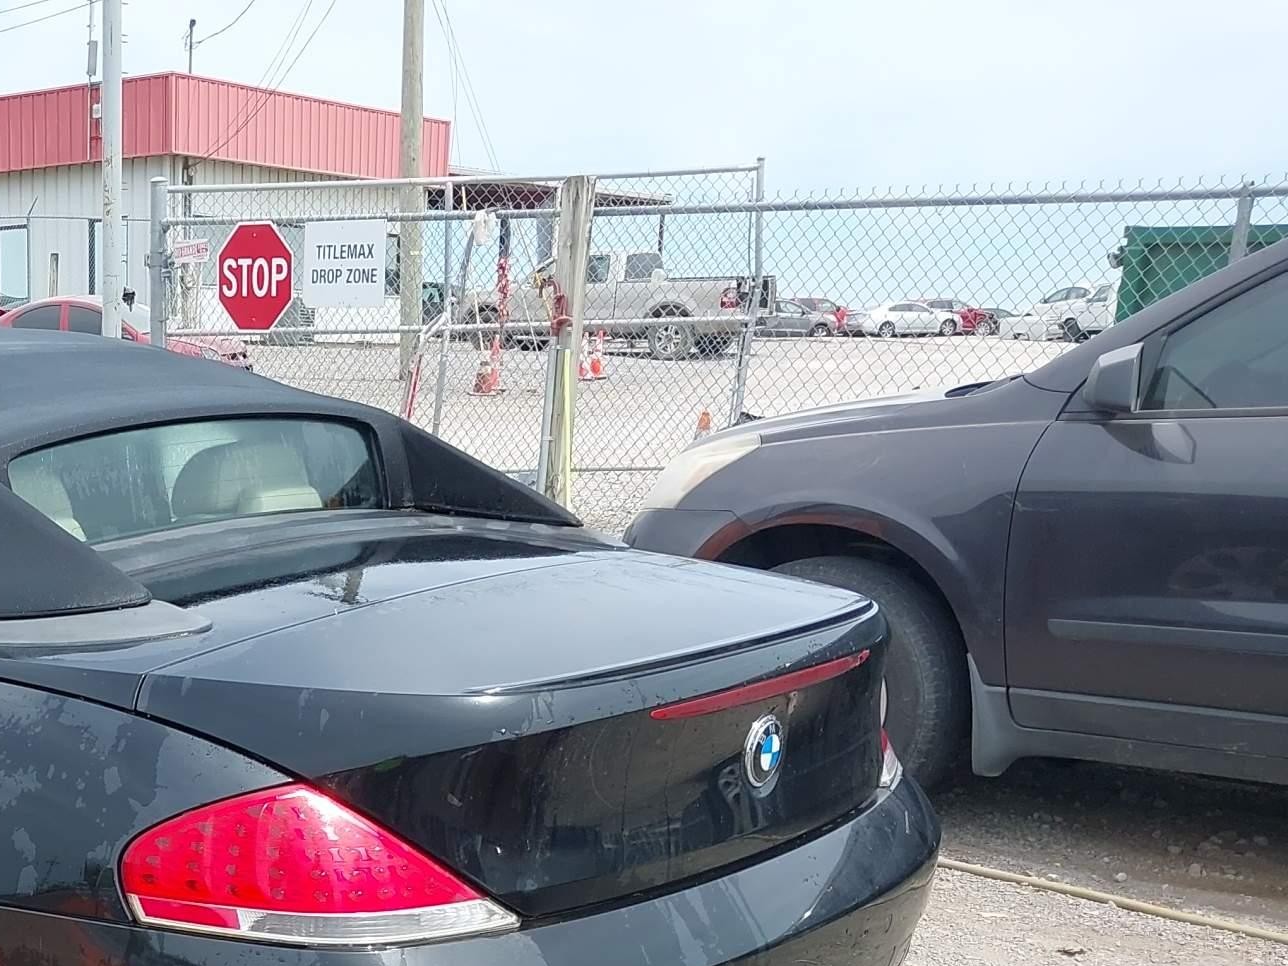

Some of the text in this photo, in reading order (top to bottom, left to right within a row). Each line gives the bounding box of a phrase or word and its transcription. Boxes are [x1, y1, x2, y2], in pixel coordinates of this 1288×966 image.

[316, 243, 375, 260] TITLEMAX
[222, 257, 288, 298] STOP
[312, 267, 378, 284] DROP ZONE
